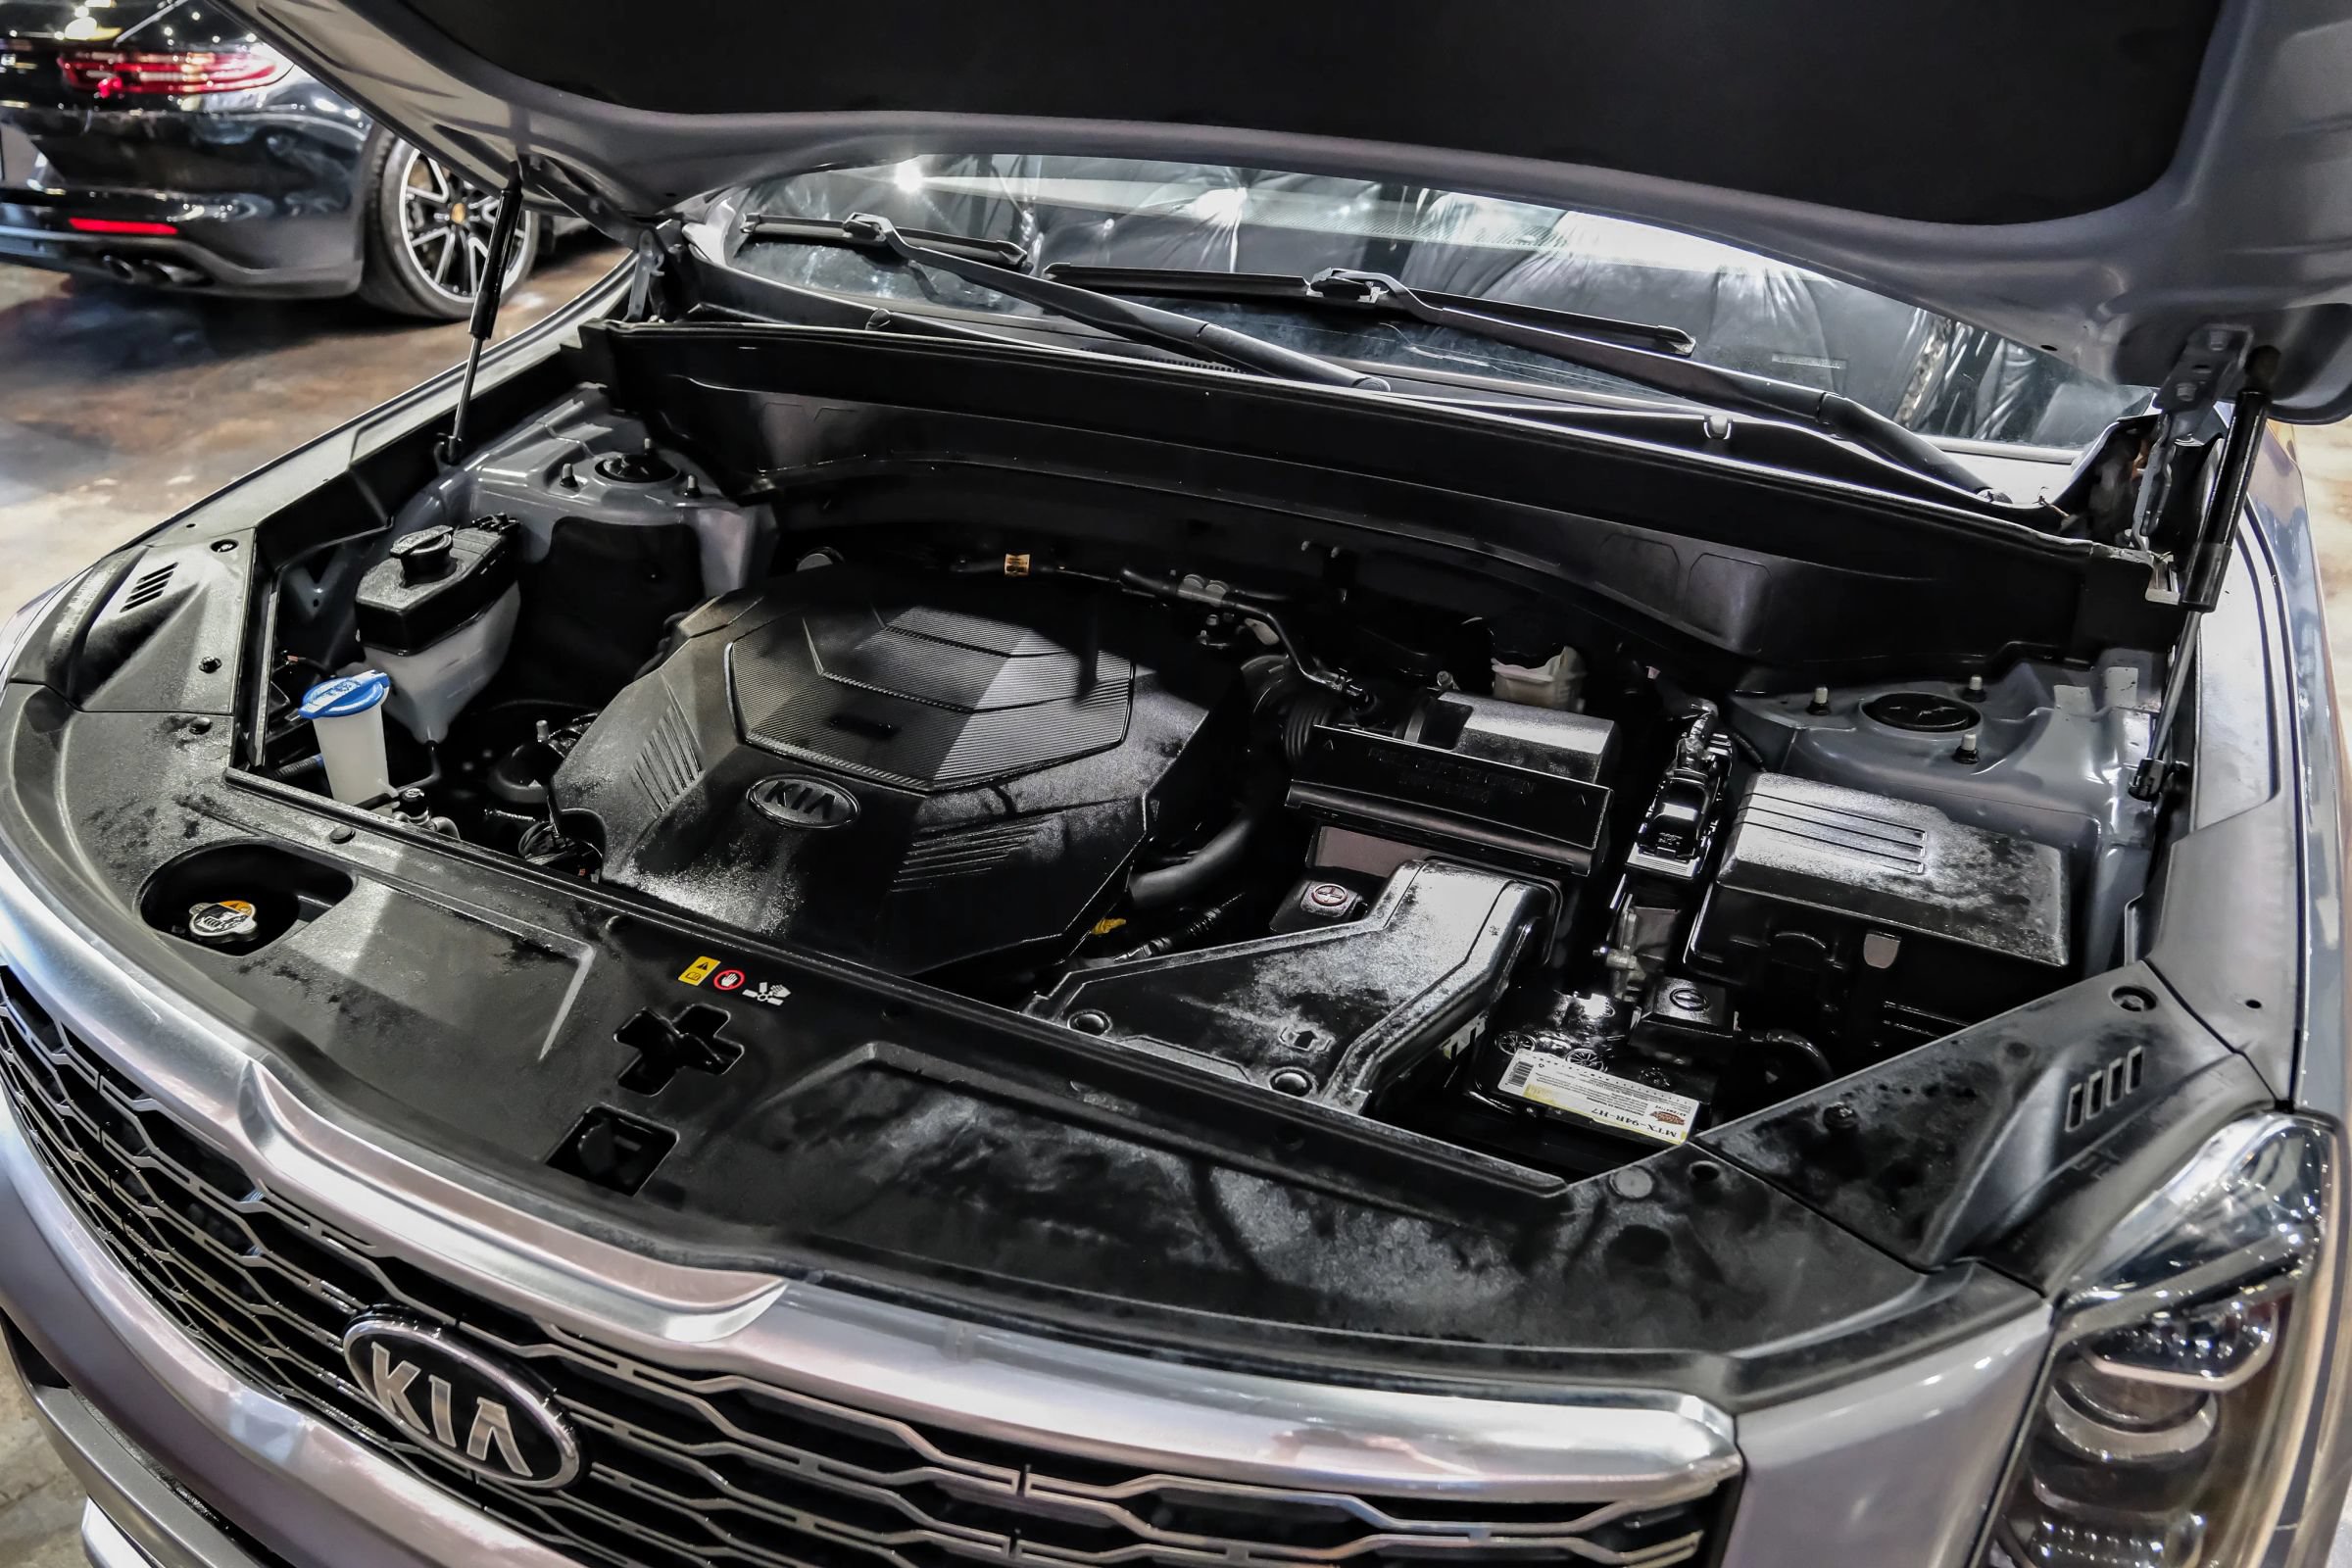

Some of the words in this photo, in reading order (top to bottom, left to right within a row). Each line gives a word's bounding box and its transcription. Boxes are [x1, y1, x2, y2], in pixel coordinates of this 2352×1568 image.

[763, 781, 837, 821] KIA
[1591, 1107, 1677, 1138] MTX-94R-H7
[371, 1342, 533, 1477] KIA
